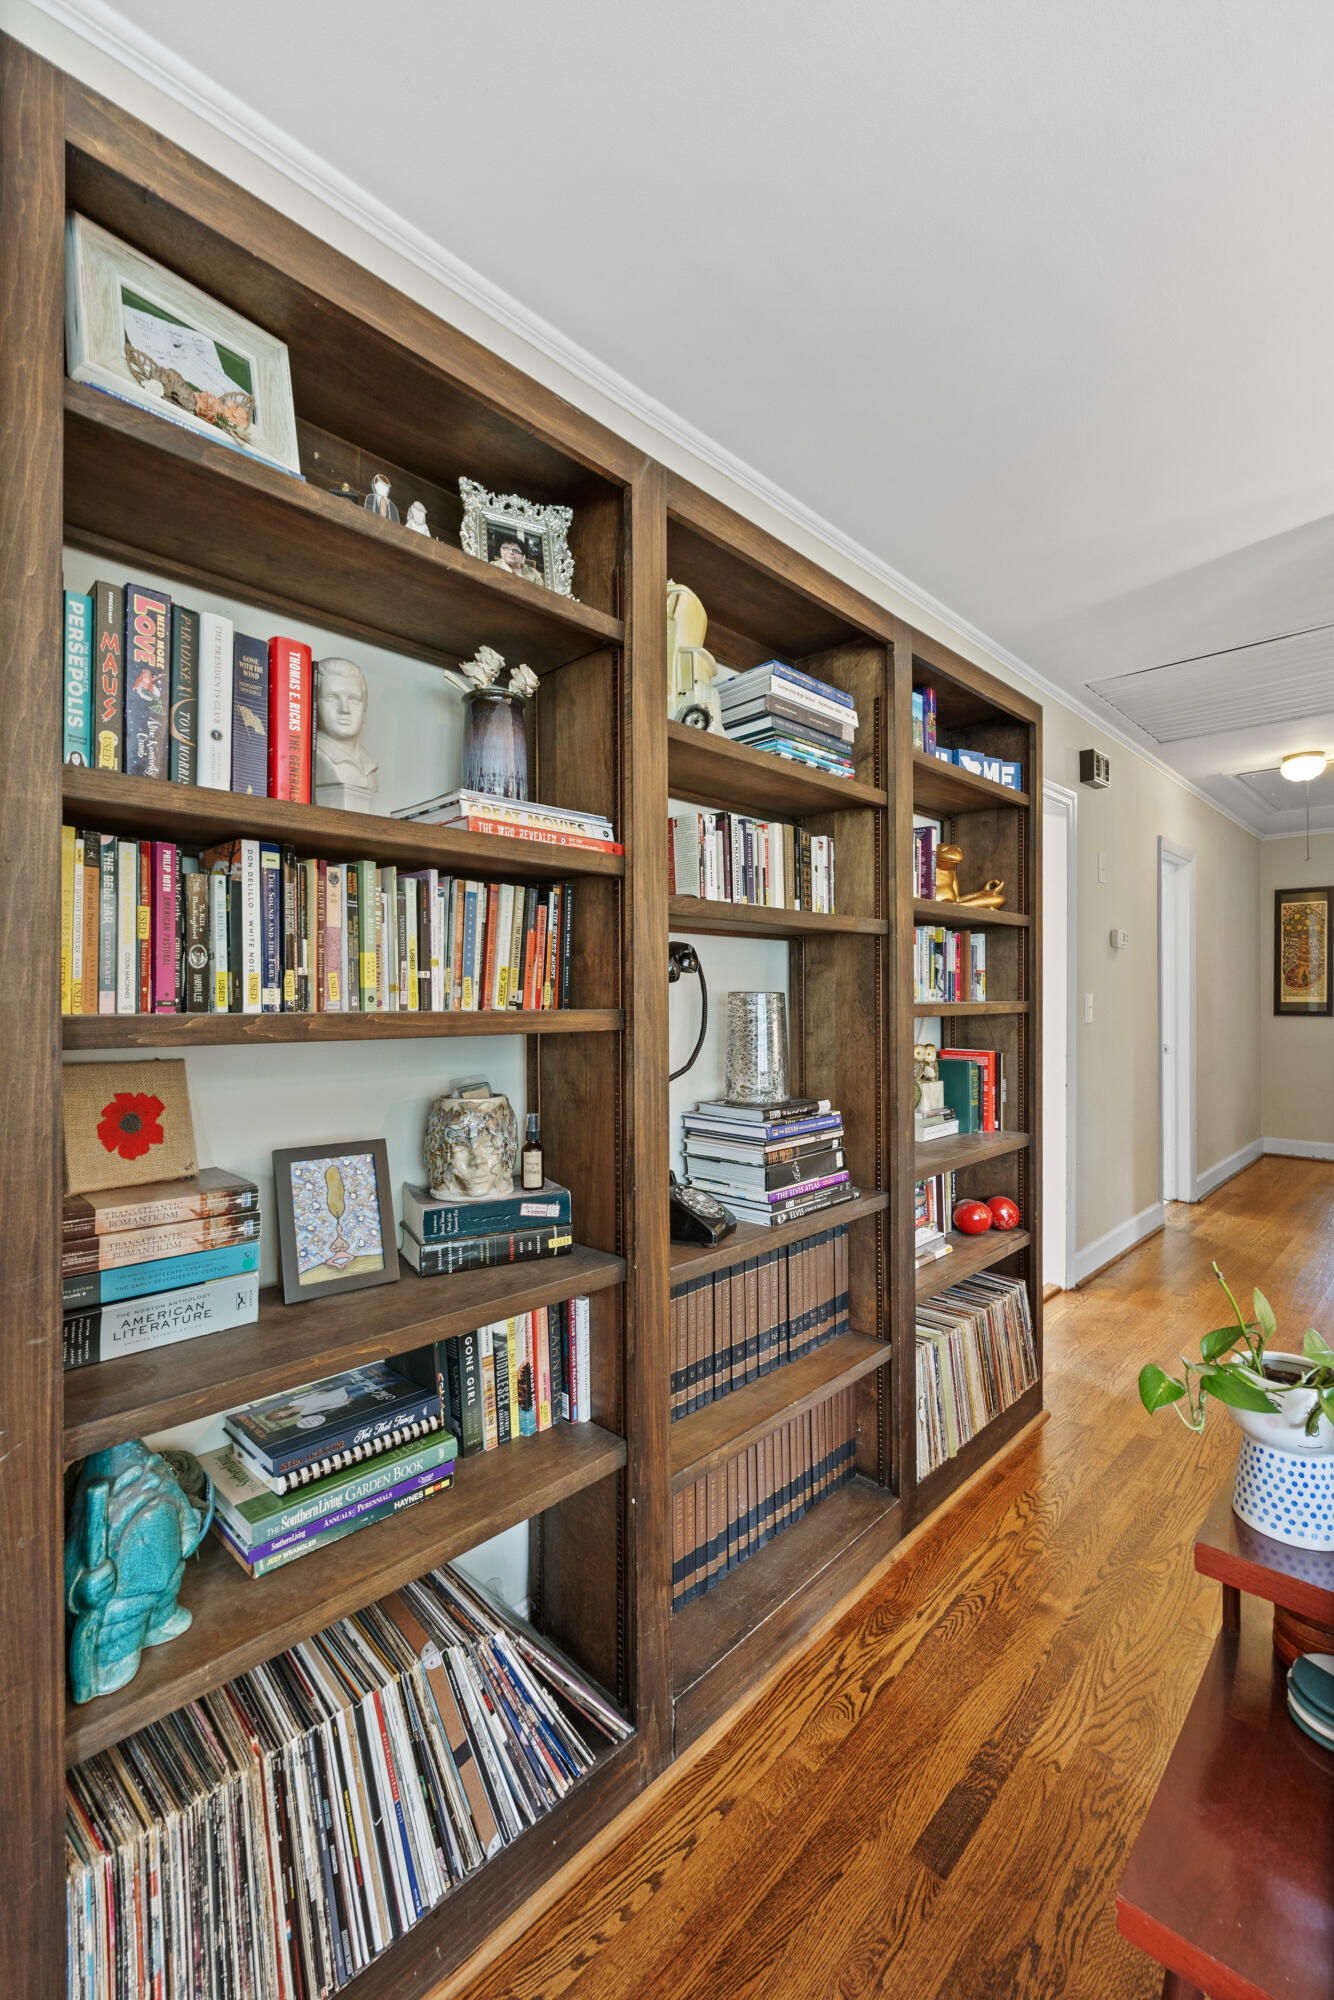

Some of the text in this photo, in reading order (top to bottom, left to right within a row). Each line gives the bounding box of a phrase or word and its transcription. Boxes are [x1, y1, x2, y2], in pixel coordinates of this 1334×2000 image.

[133, 593, 166, 666] LOVE
[156, 614, 165, 670] NEED MORE
[180, 613, 192, 680] PARADISE
[242, 655, 258, 664] GONE
[68, 600, 85, 728] PERSEPOLIS
[100, 632, 120, 722] MAUS
[240, 660, 263, 674] WITH THE
[242, 670, 260, 680] WIND
[289, 651, 301, 732] THOMAS E. RICKS
[179, 711, 191, 740] TONI
[102, 736, 113, 762] USED
[289, 735, 300, 803] THE GENERALS
[468, 803, 586, 835] GREAT MOVIES
[478, 822, 556, 844] THE WHO REVEALED
[162, 849, 172, 892] PHILIP ROTH
[103, 851, 114, 924] THE BELL JAR
[86, 874, 95, 946] Pride and Prejudice
[190, 896, 199, 939] Mockingbird
[200, 904, 206, 912] To
[162, 897, 171, 966] AMERICAN PASTORAL
[73, 982, 82, 1008] USED
[194, 974, 202, 1002] HARPER LEE
[329, 976, 338, 998] USED
[776, 1182, 820, 1200] THE ELVIS ATLAS
[104, 1203, 182, 1219] TRANSATLANTIC
[110, 1211, 178, 1228] ROMANTICISM
[789, 1208, 804, 1219] ELVIS
[108, 1232, 184, 1250] TRANSATLANTIC
[113, 1241, 183, 1259] ROMANTICISM
[186, 1263, 213, 1272] CENTURY
[202, 1265, 229, 1274] CENTURY
[120, 1301, 205, 1329] AMERICAN
[135, 1303, 166, 1315] NORTON
[168, 1293, 212, 1306] ANTHOLOGY
[113, 1309, 212, 1341] LITERATURE
[465, 1336, 476, 1406] GONE GIRL
[496, 1352, 509, 1408] MIDDLESEX
[353, 1413, 415, 1443] Not That Fancy
[280, 1458, 303, 1472] REBA
[306, 1440, 344, 1463] McENTIRE
[266, 1526, 281, 1537] THE
[281, 1506, 319, 1529] Southern
[319, 1493, 344, 1516] Living
[345, 1474, 391, 1501] GARDEN
[393, 1459, 424, 1481] BOOK
[324, 1492, 392, 1528] ANNUALS PERENNIALS
[394, 1491, 424, 1509] HAYNES
[266, 1539, 317, 1566] JEEP WRANGLER
